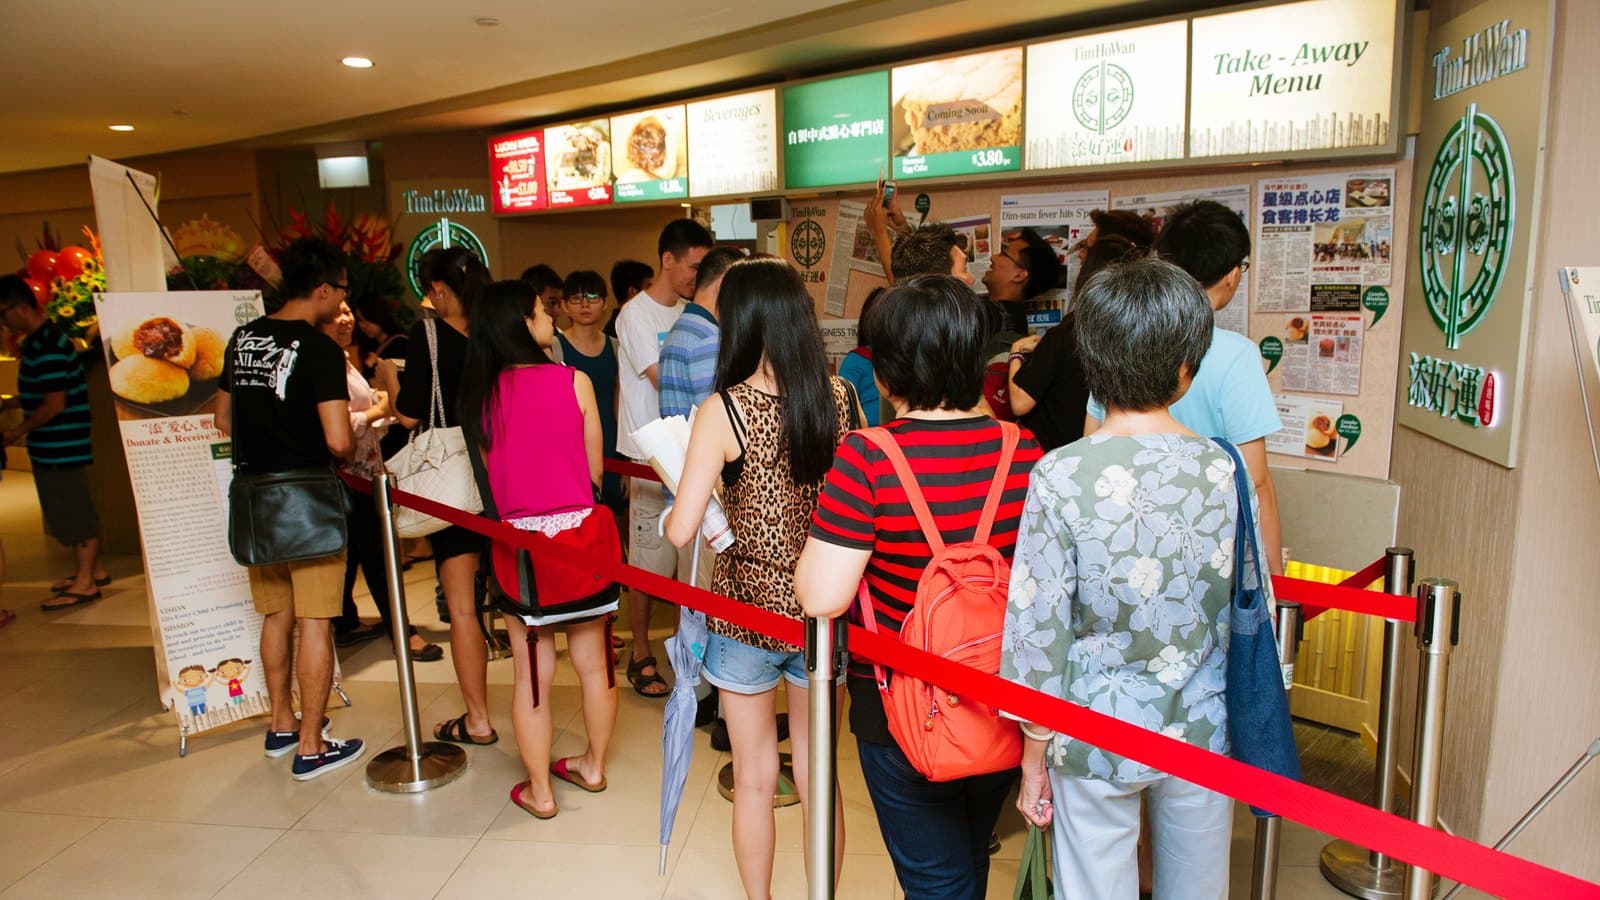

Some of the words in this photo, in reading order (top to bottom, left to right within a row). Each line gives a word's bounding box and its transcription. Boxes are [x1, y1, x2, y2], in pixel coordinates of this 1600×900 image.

[1072, 41, 1136, 62] TimHoWan
[1214, 49, 1271, 76] Take
[1292, 40, 1369, 67] Away
[1432, 20, 1528, 99] TimHoWan
[1249, 73, 1323, 97] Menu
[704, 103, 761, 123] Beverages
[927, 105, 963, 121] Coming
[964, 105, 989, 116] Soon
[972, 149, 1003, 167] $3.80
[402, 188, 486, 214] TimHoWan
[1263, 189, 1341, 207] 星级点心店
[792, 206, 826, 217] TimHoWan
[1002, 210, 1037, 221] Dim-sum
[1039, 208, 1059, 219] fever
[1060, 207, 1074, 218] hits
[1075, 207, 1091, 219] S'p
[1262, 207, 1341, 225] 食客排长龙
[1071, 229, 1079, 238] T
[800, 271, 819, 284] 好運
[819, 328, 846, 337] USINESS
[237, 330, 284, 361] Italy
[1408, 351, 1483, 429] 添好運
[127, 439, 160, 448] Donate
[163, 436, 171, 444] &
[175, 433, 210, 442] Receive
